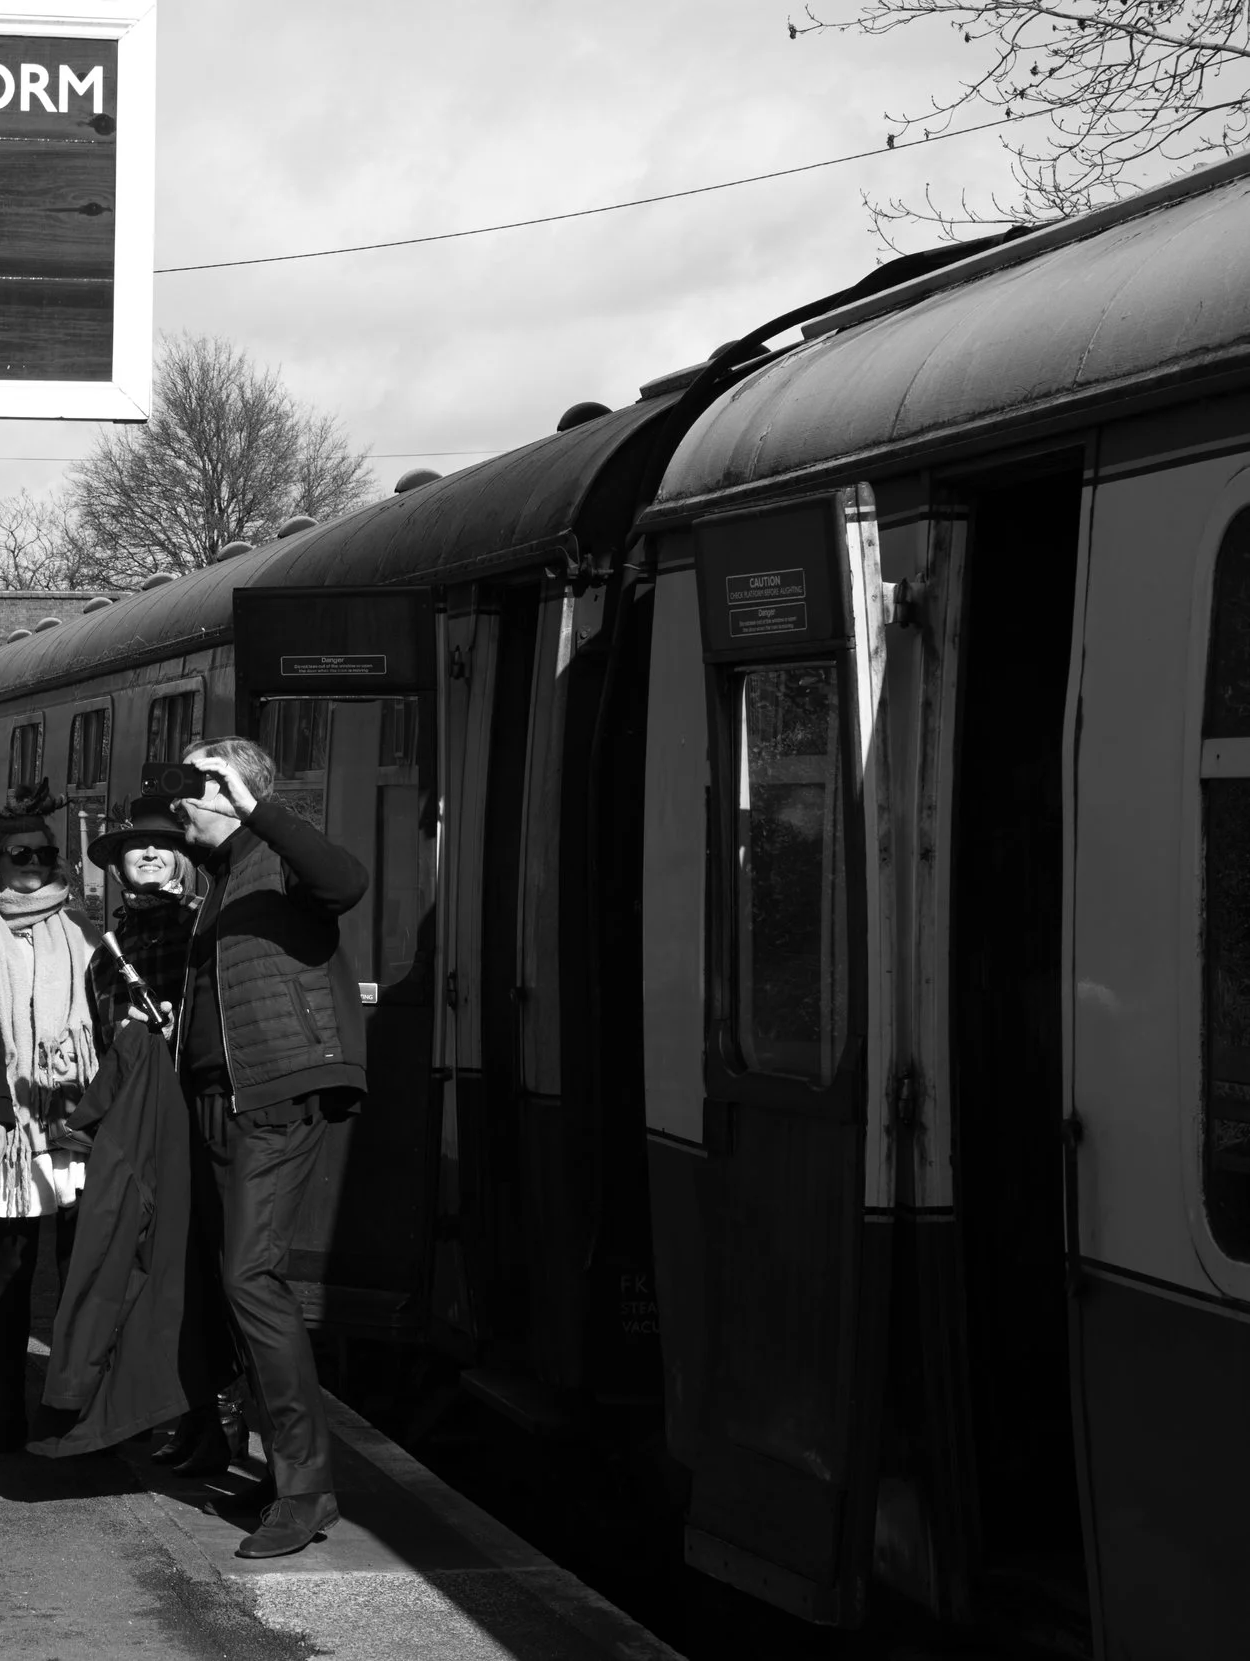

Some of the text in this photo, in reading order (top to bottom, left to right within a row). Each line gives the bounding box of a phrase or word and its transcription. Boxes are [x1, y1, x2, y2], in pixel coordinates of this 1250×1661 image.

[750, 576, 781, 588] CAUTION
[730, 585, 803, 600] CHECK PLATFORM BEFORE ALIGHTING
[758, 608, 776, 618] Danger
[619, 1301, 661, 1315] STEA
